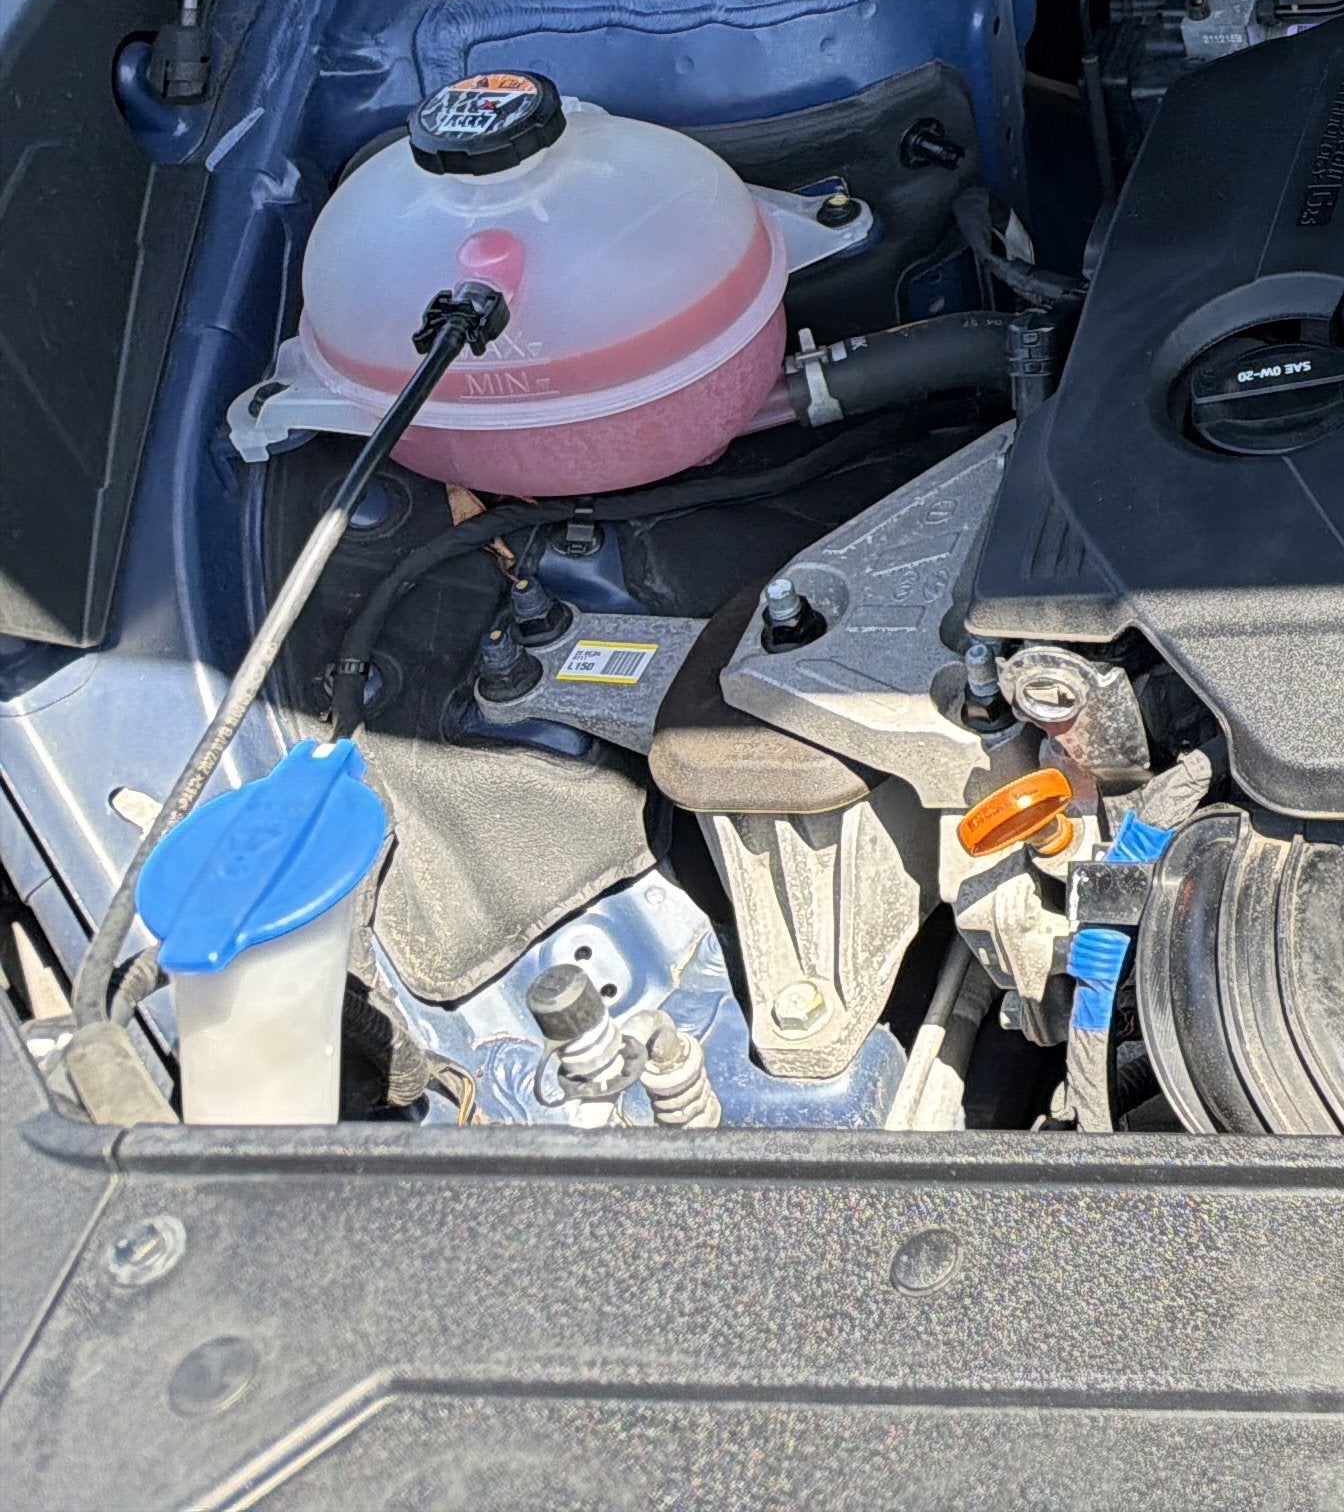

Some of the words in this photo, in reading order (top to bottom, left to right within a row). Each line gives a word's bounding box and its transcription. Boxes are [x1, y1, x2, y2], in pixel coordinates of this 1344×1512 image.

[1238, 365, 1282, 383] 0W-20
[1284, 360, 1312, 375] SAE
[464, 371, 531, 395] MIN
